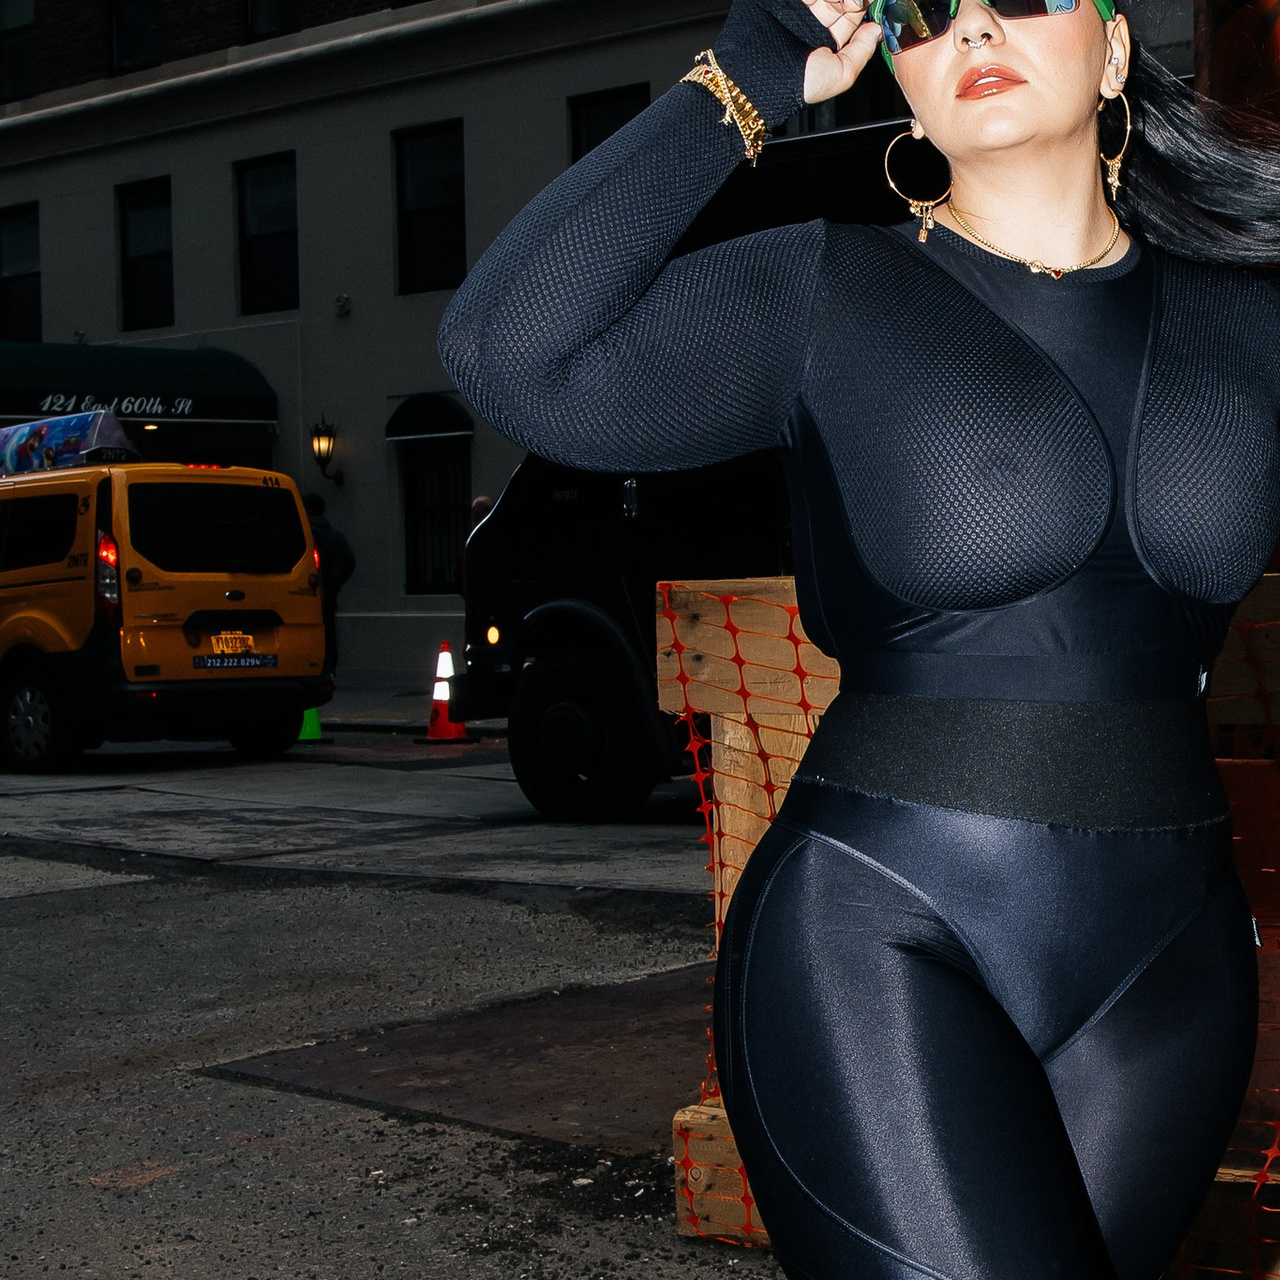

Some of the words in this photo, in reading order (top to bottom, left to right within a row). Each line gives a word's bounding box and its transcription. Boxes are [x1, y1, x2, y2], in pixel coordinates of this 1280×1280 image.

[40, 394, 77, 412] 121
[80, 395, 119, 412] East
[121, 396, 166, 414] 60th
[171, 397, 194, 415] St
[102, 449, 127, 461] 2N72
[67, 553, 89, 568] 2N72
